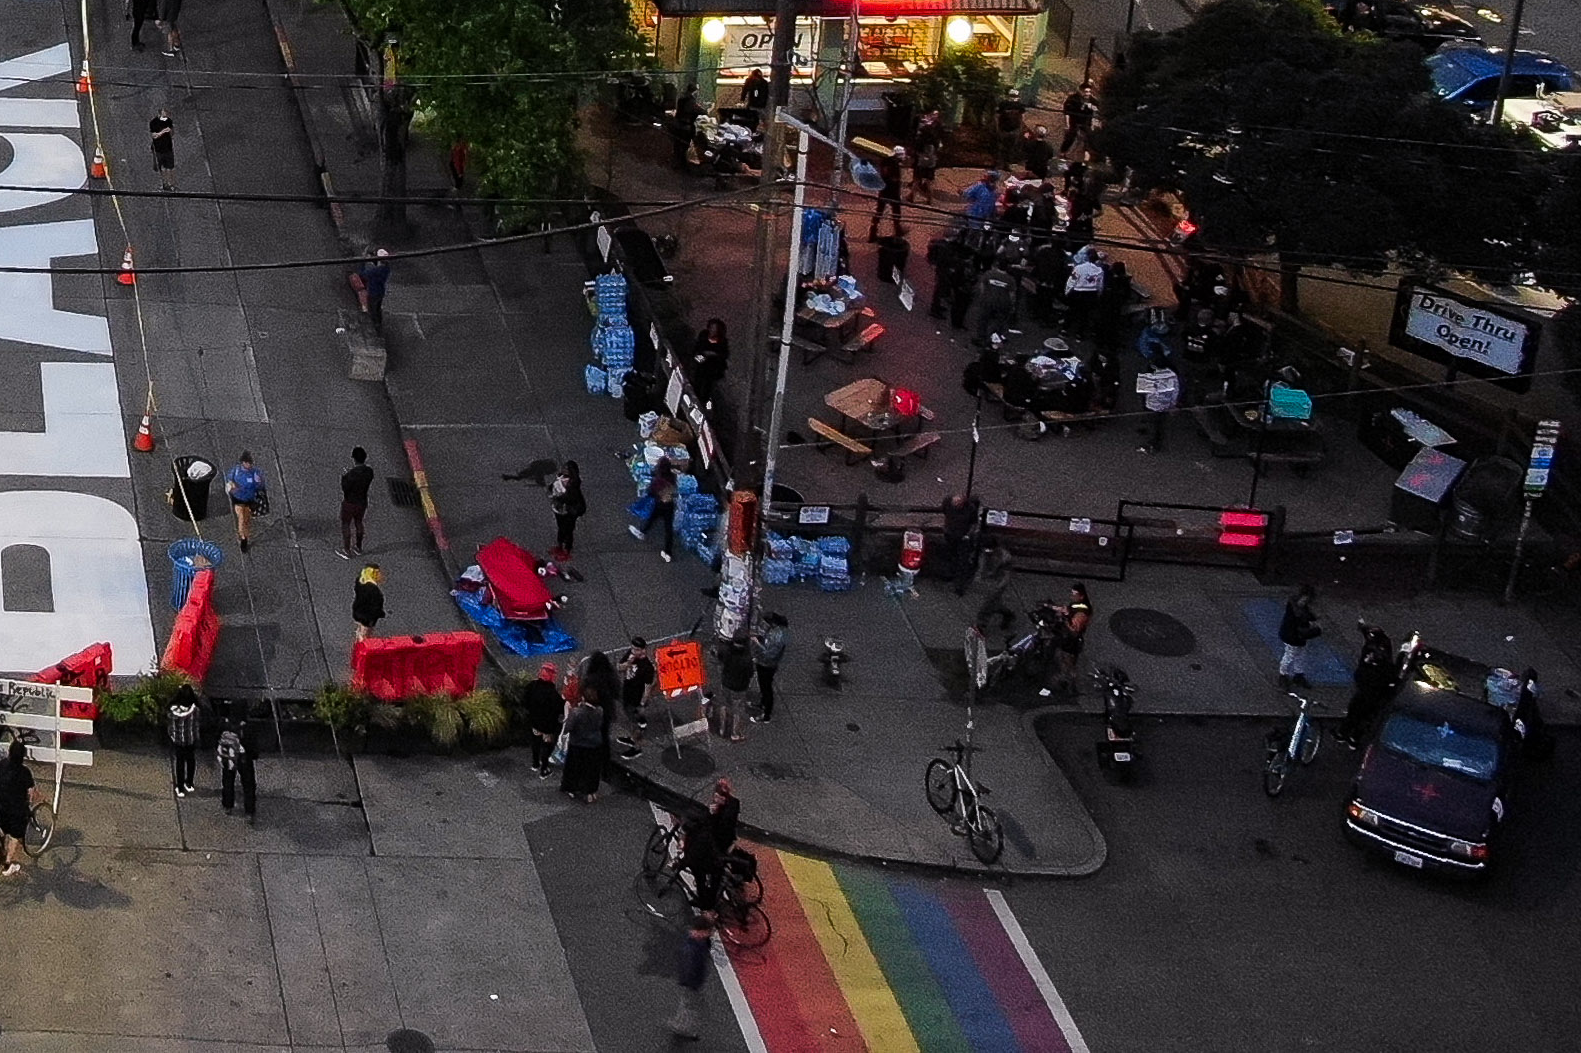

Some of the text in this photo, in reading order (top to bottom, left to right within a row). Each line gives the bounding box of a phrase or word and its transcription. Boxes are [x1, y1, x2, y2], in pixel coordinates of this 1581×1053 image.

[1419, 294, 1517, 342] Drive Thru
[1436, 324, 1491, 356] Open!
